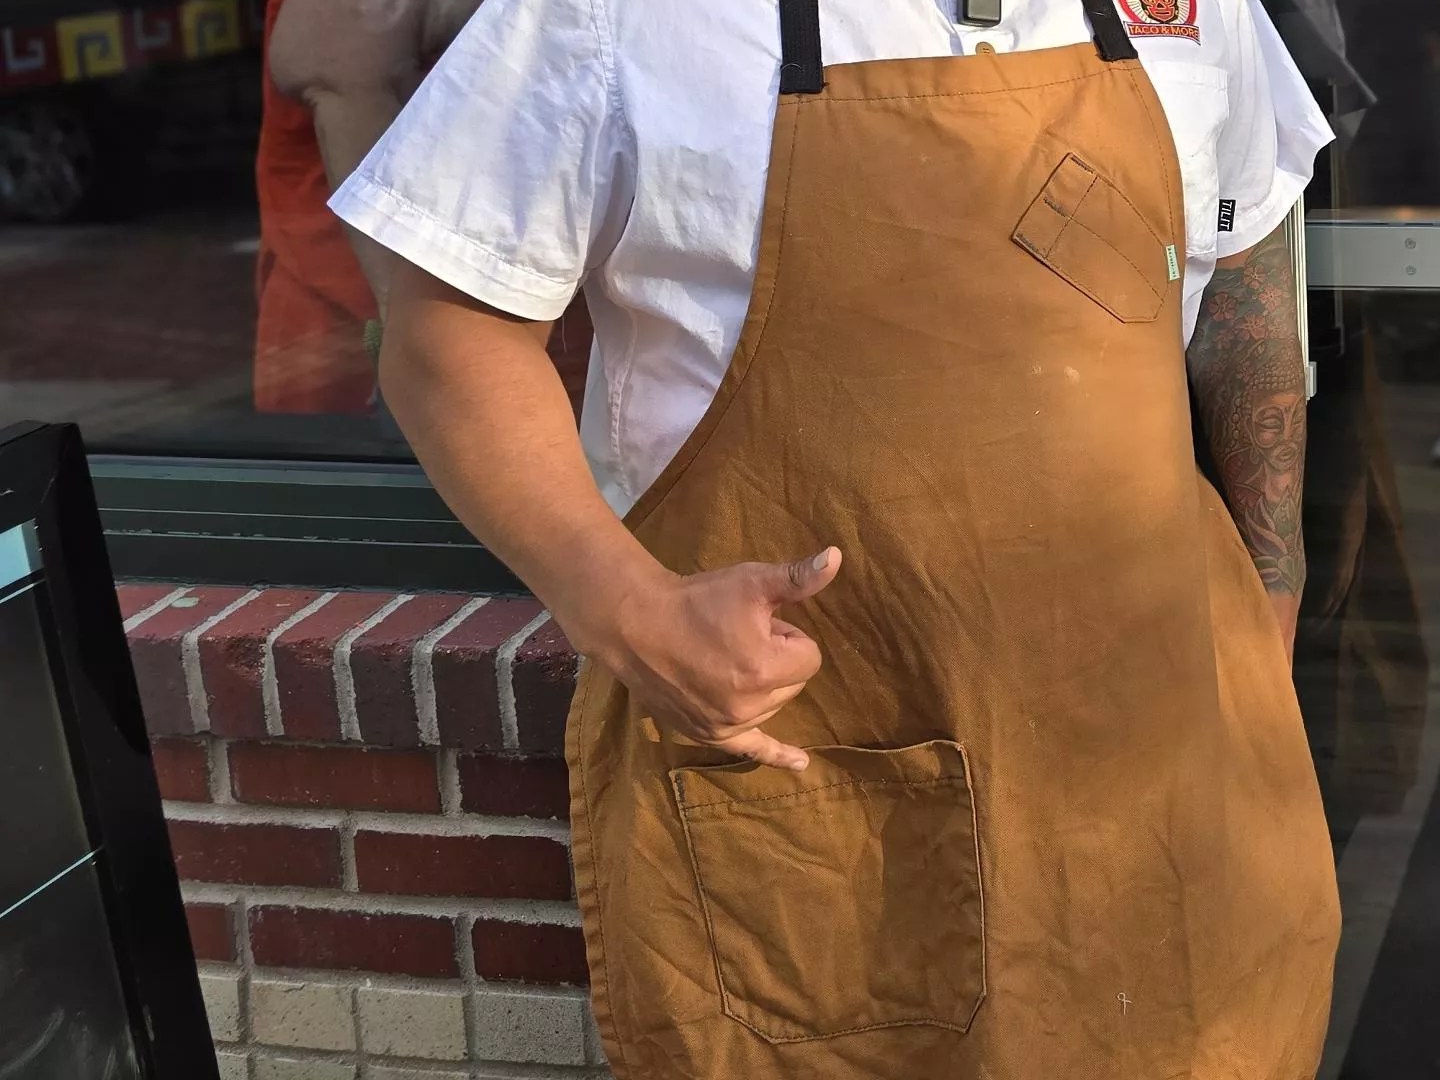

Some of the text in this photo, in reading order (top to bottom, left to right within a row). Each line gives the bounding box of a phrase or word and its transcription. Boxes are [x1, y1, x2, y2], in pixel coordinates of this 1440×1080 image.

[1129, 26, 1158, 34] TACO
[1172, 26, 1198, 37] MORE
[1220, 201, 1233, 230] TILIT
